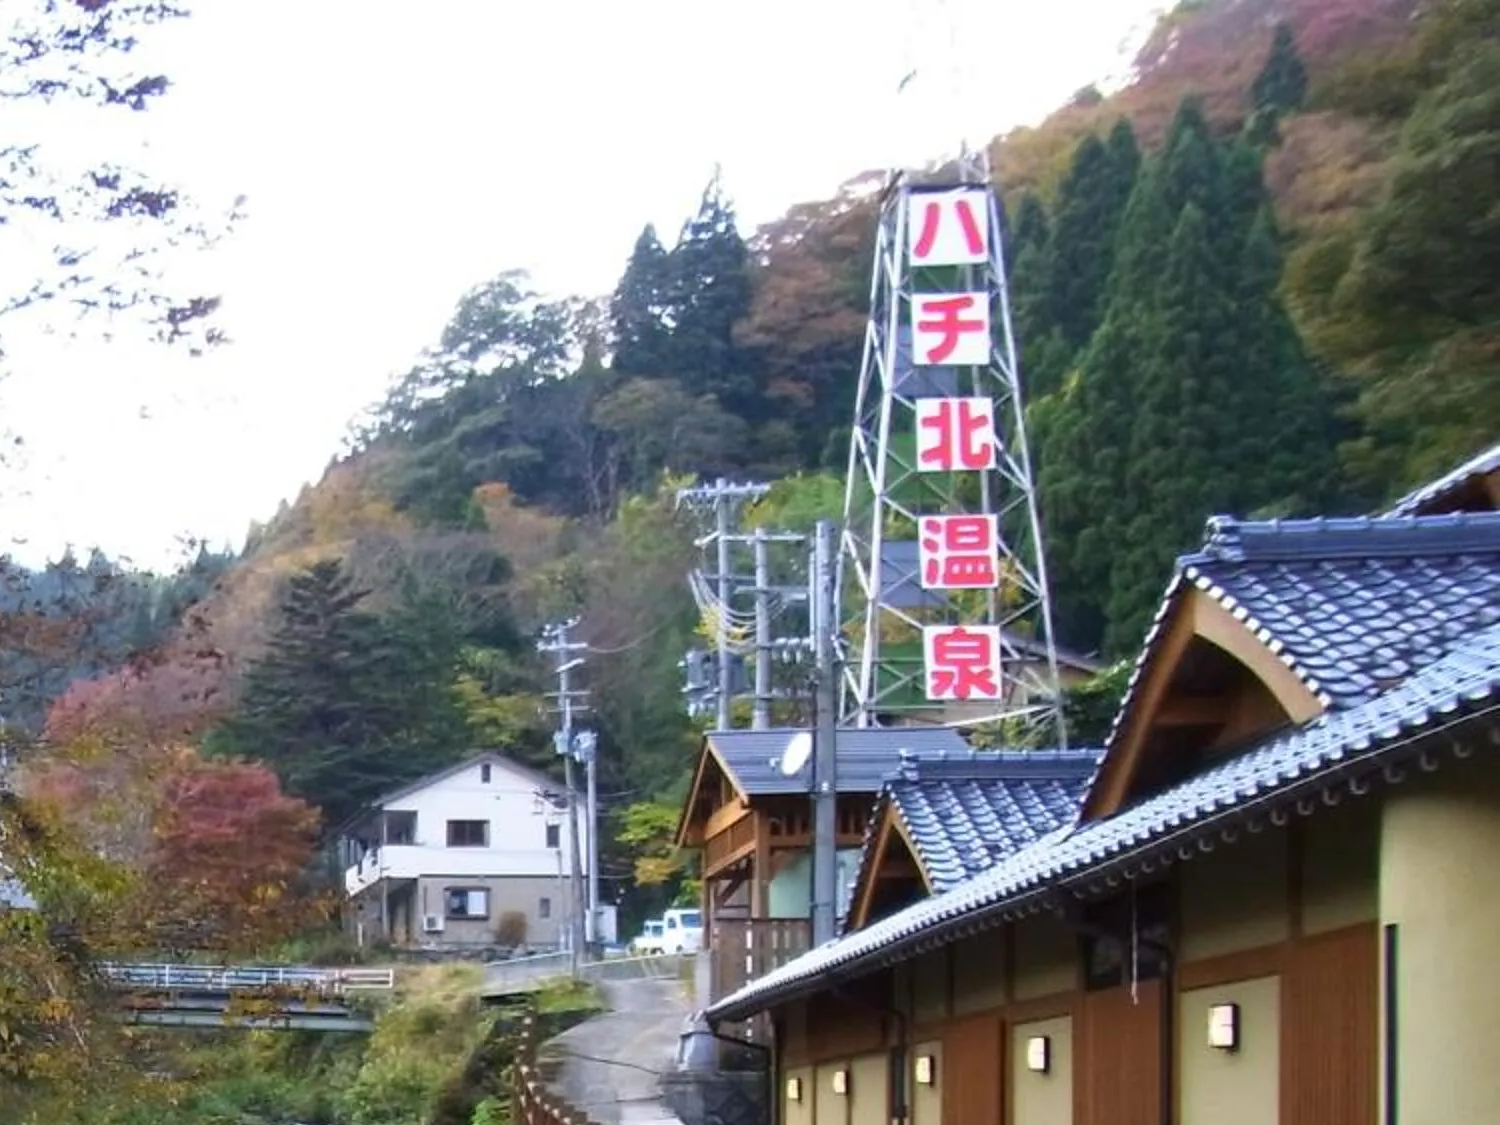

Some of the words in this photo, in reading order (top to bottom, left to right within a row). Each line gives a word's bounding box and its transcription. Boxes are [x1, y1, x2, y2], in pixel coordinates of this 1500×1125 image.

[913, 200, 1000, 700] ハチ北温泉
